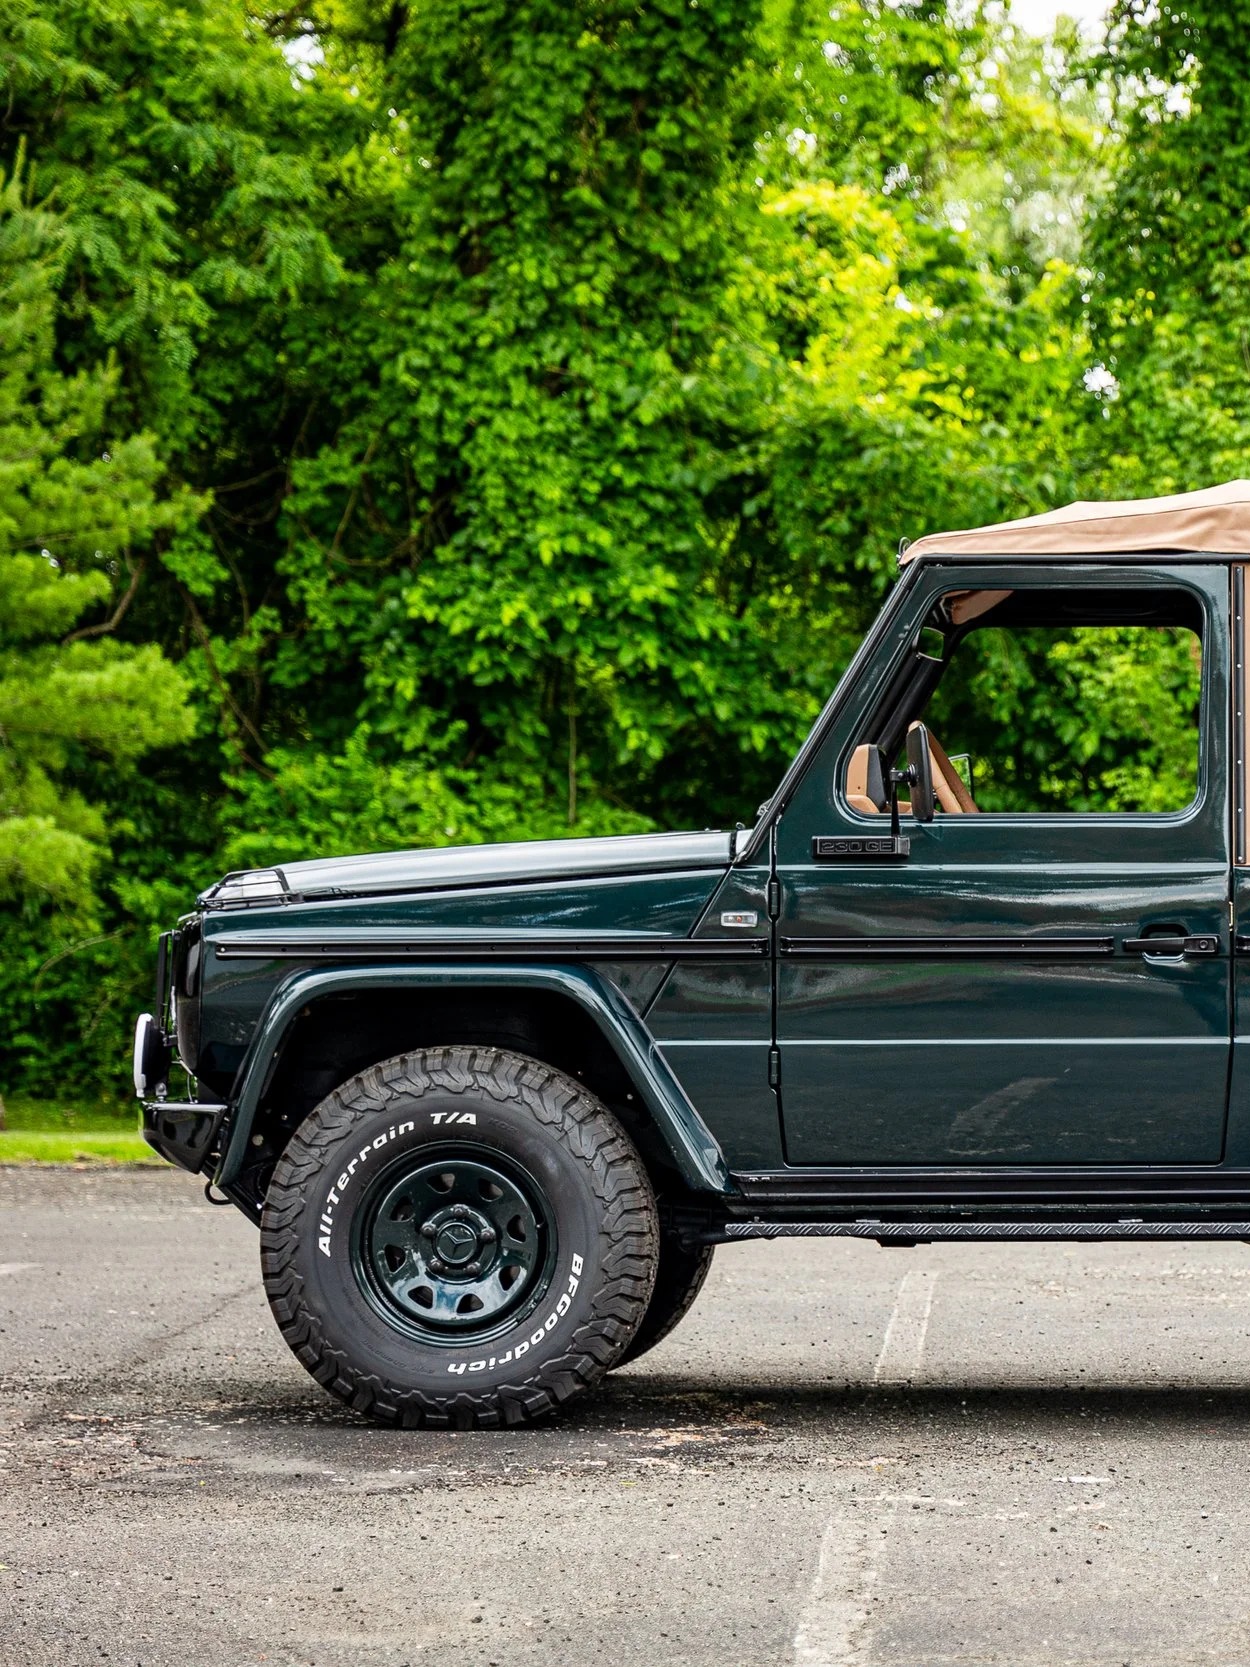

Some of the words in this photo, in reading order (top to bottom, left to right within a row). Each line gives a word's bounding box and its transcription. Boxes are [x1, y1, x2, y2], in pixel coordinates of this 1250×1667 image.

[821, 842, 862, 853] 230
[865, 842, 893, 853] GE
[318, 1120, 415, 1258] All-Terrain
[429, 1111, 477, 1126] T/A
[446, 1252, 584, 1375] BFGoodrich
